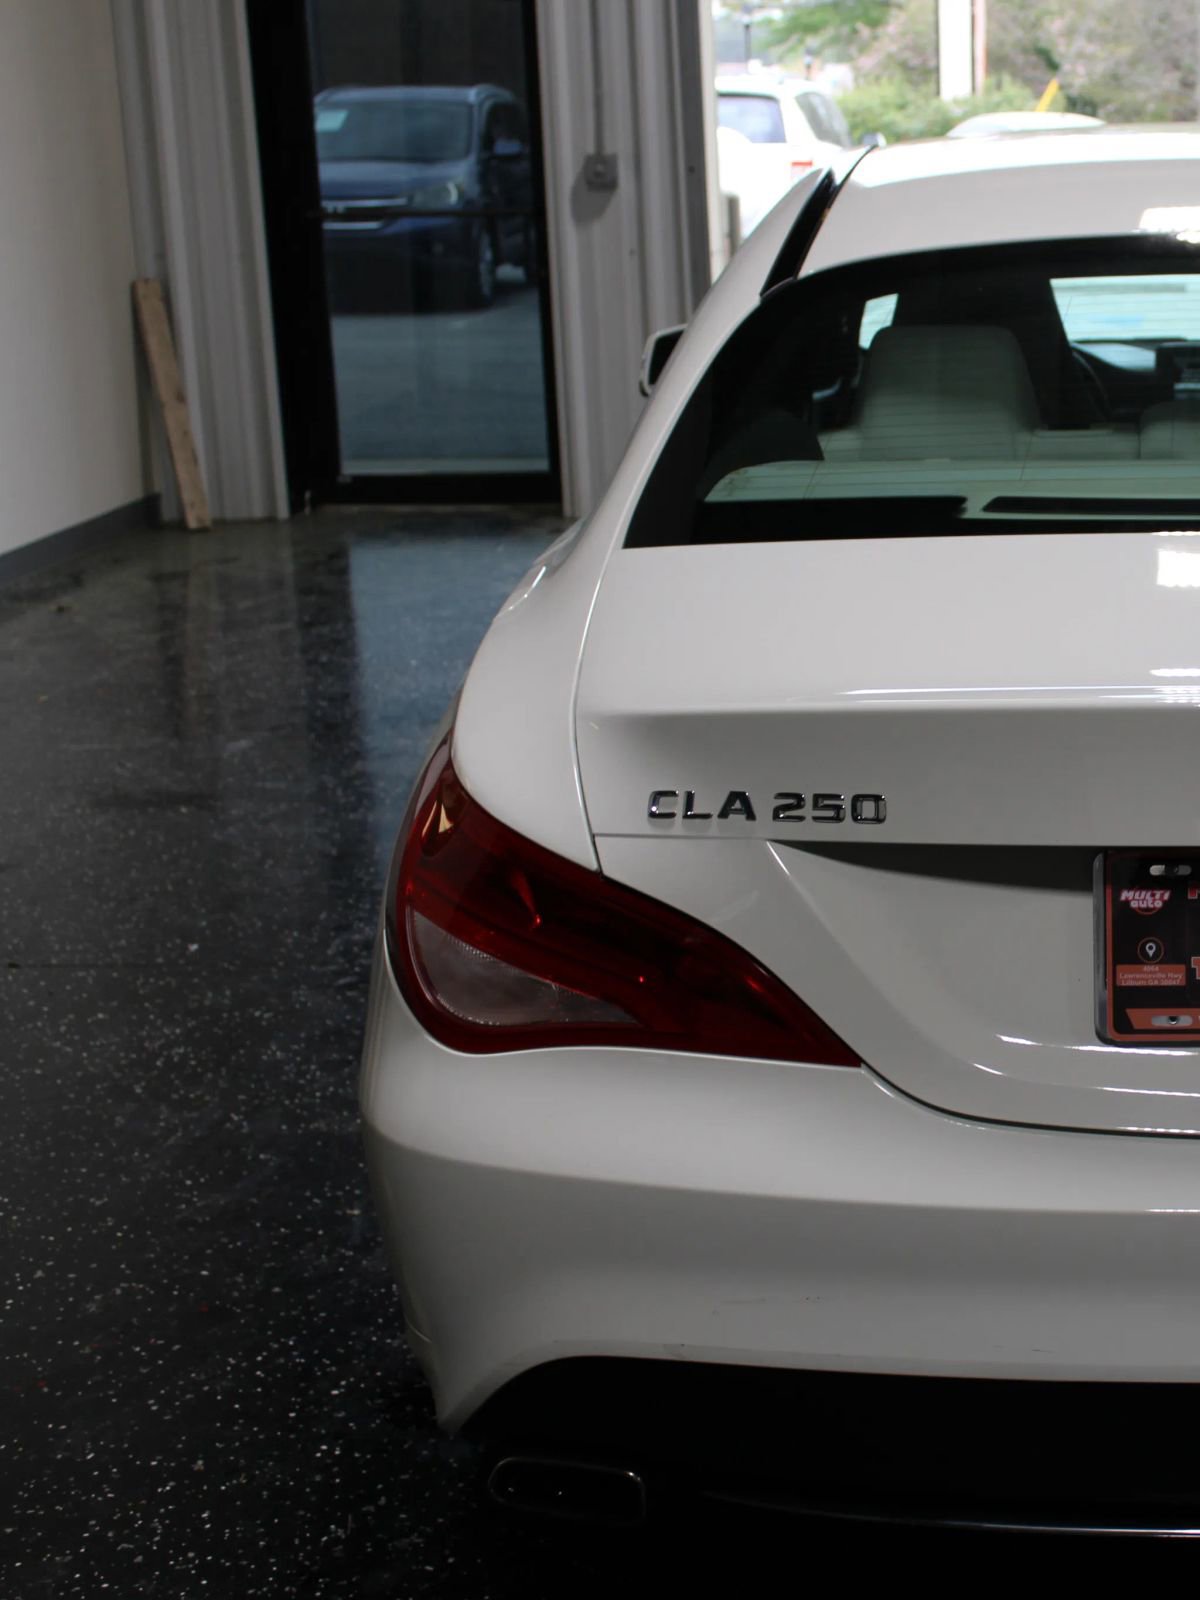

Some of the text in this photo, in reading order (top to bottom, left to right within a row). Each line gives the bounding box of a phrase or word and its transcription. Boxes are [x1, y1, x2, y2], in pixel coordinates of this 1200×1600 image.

[648, 790, 886, 824] CLA 250
[1120, 889, 1171, 901] MULTI
[1130, 900, 1164, 909] auto
